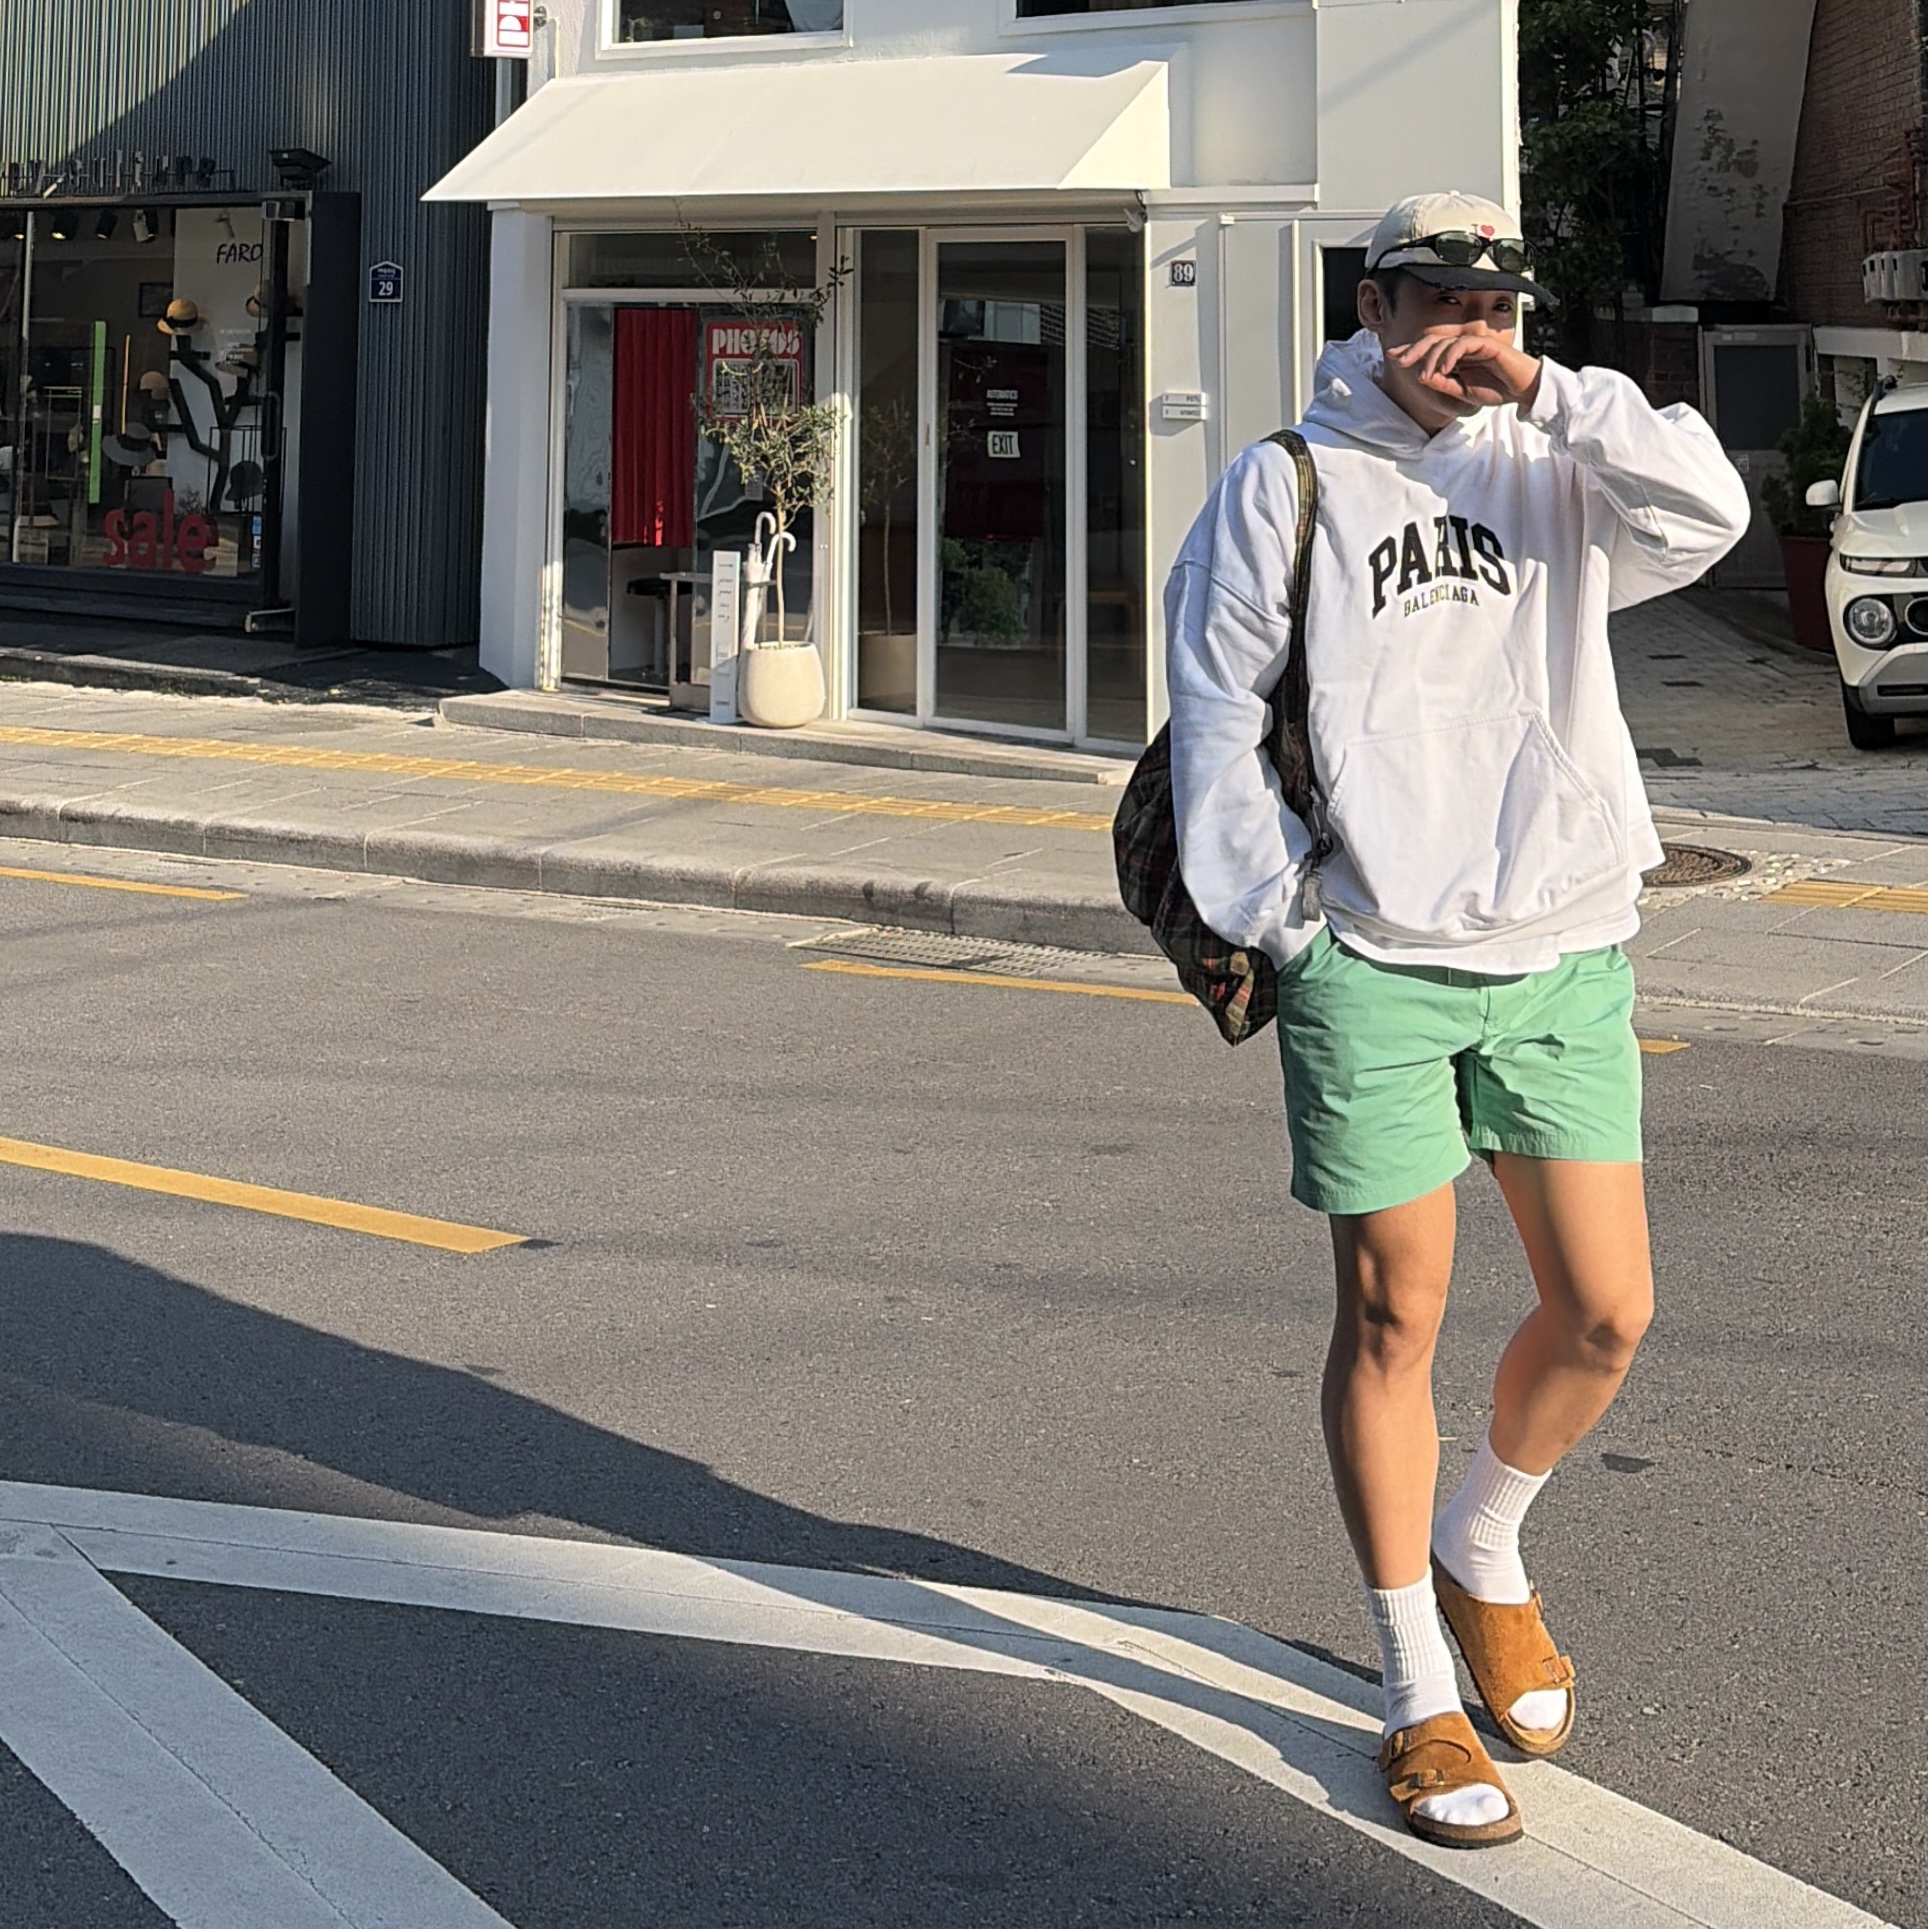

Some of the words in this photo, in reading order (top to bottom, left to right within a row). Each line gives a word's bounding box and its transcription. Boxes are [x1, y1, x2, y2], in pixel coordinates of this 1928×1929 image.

[216, 243, 263, 264] FARO
[1173, 263, 1194, 283] 89
[378, 281, 394, 296] 29
[992, 434, 1014, 455] EXIT
[102, 488, 210, 575] sale
[1368, 514, 1511, 620] PARIS
[1404, 584, 1480, 618] BALENCIAGA
